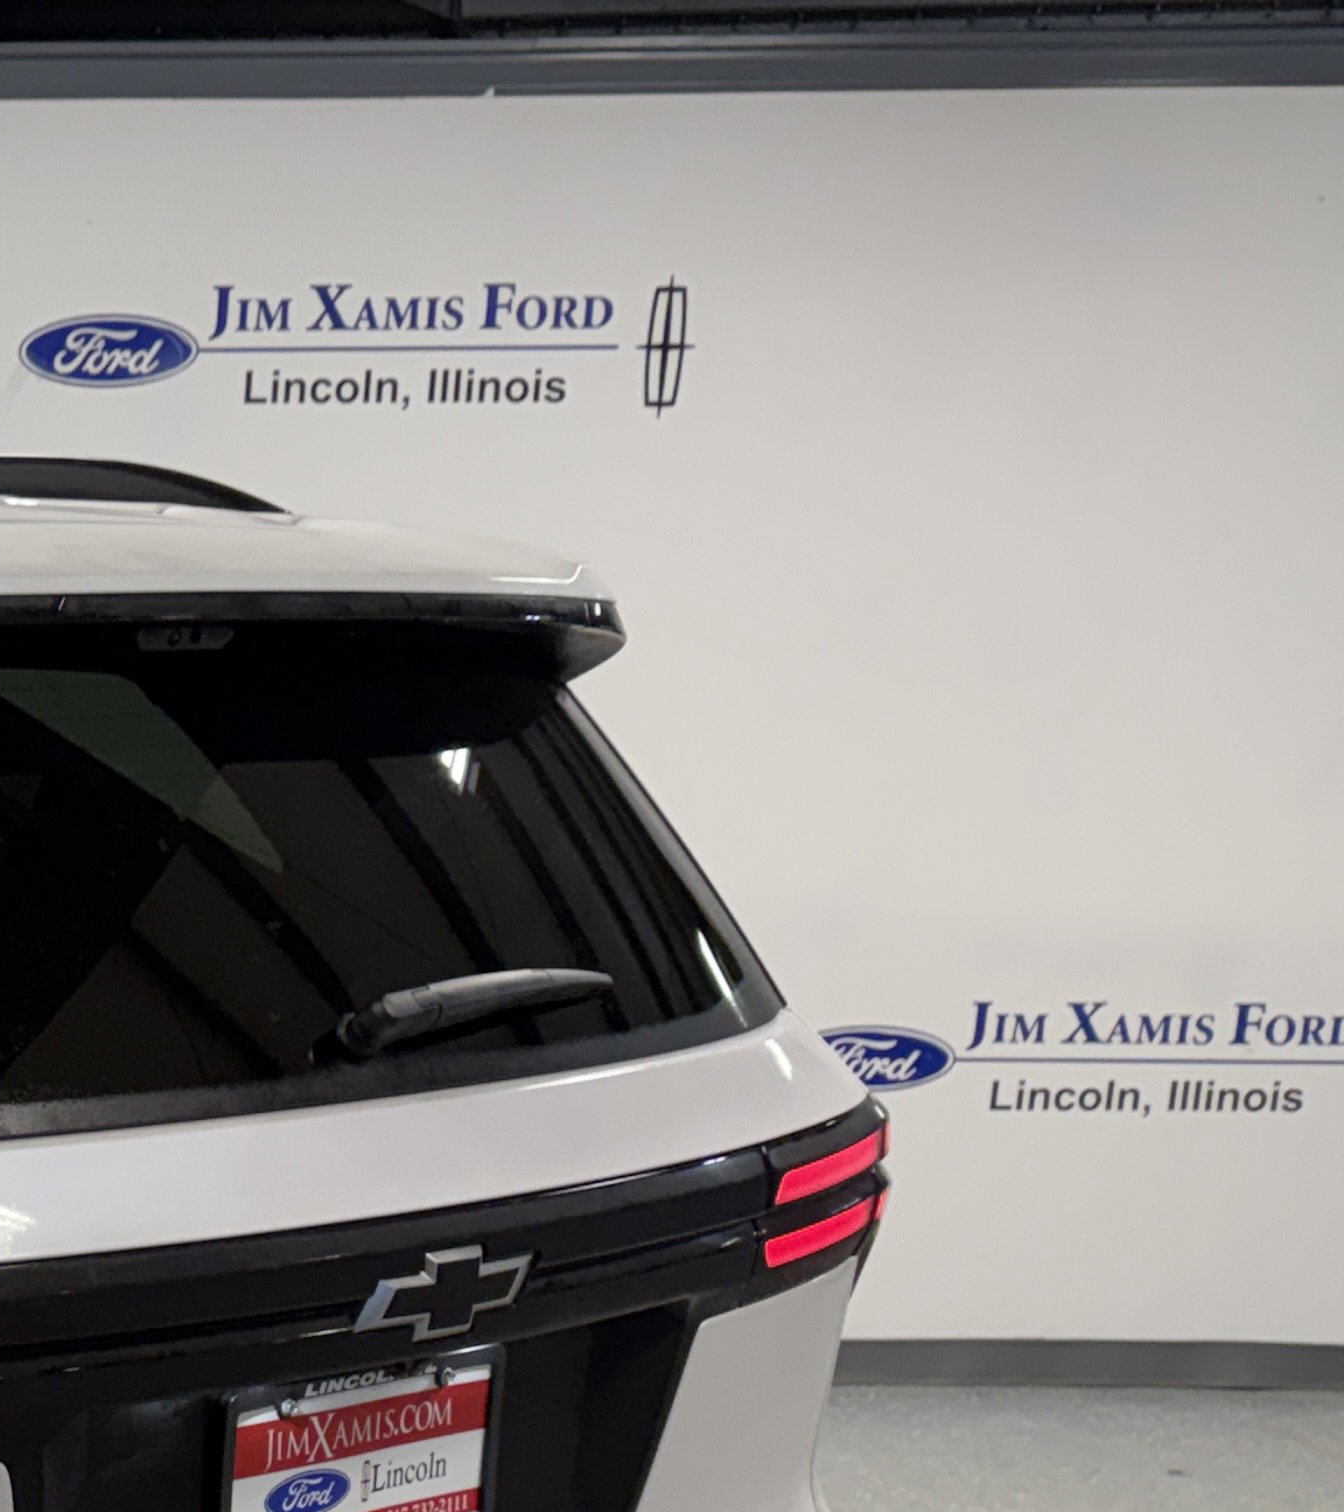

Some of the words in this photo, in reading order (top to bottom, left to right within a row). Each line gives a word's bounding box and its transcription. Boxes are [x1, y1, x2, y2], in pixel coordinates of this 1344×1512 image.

[209, 284, 292, 341] JIM
[306, 283, 464, 332] XAMIS
[479, 283, 614, 331] FORD
[53, 327, 161, 376] Ford
[243, 370, 410, 409] Lincoln,
[427, 367, 567, 404] Illinois
[966, 1000, 1050, 1051] JIM
[1061, 1001, 1216, 1046] XAMIS
[989, 1079, 1152, 1117] Lincoln,
[1166, 1080, 1304, 1113] Illinois
[304, 1368, 396, 1398] LINCOL
[264, 1397, 453, 1473] JIMXAMIS.COM
[371, 1452, 448, 1493] Lincoln
[282, 1477, 334, 1512] Ford
